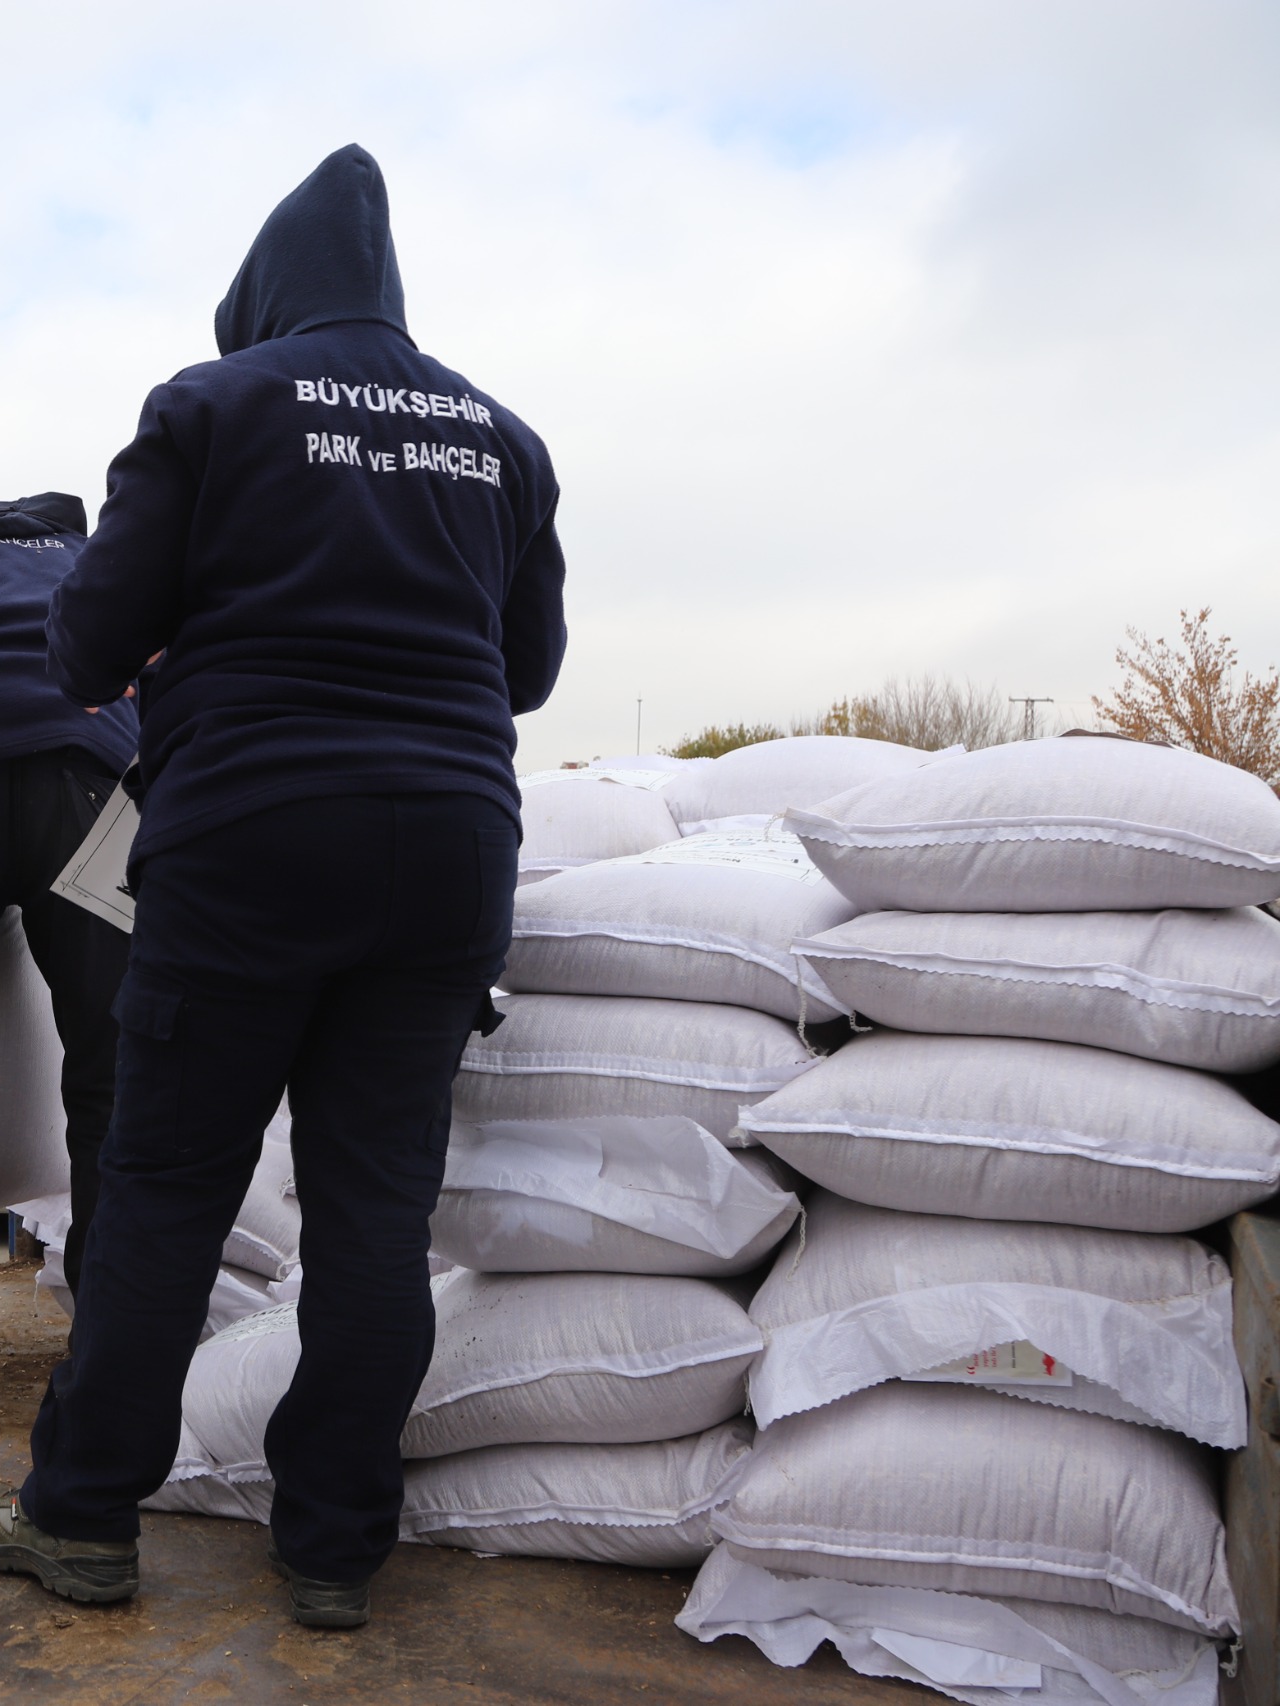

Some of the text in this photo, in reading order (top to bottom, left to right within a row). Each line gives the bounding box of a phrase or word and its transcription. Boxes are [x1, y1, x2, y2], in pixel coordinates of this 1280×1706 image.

[295, 376, 494, 427] BÜYÜKŞEHİR
[305, 432, 502, 488] PARK VE BAHÇELER
